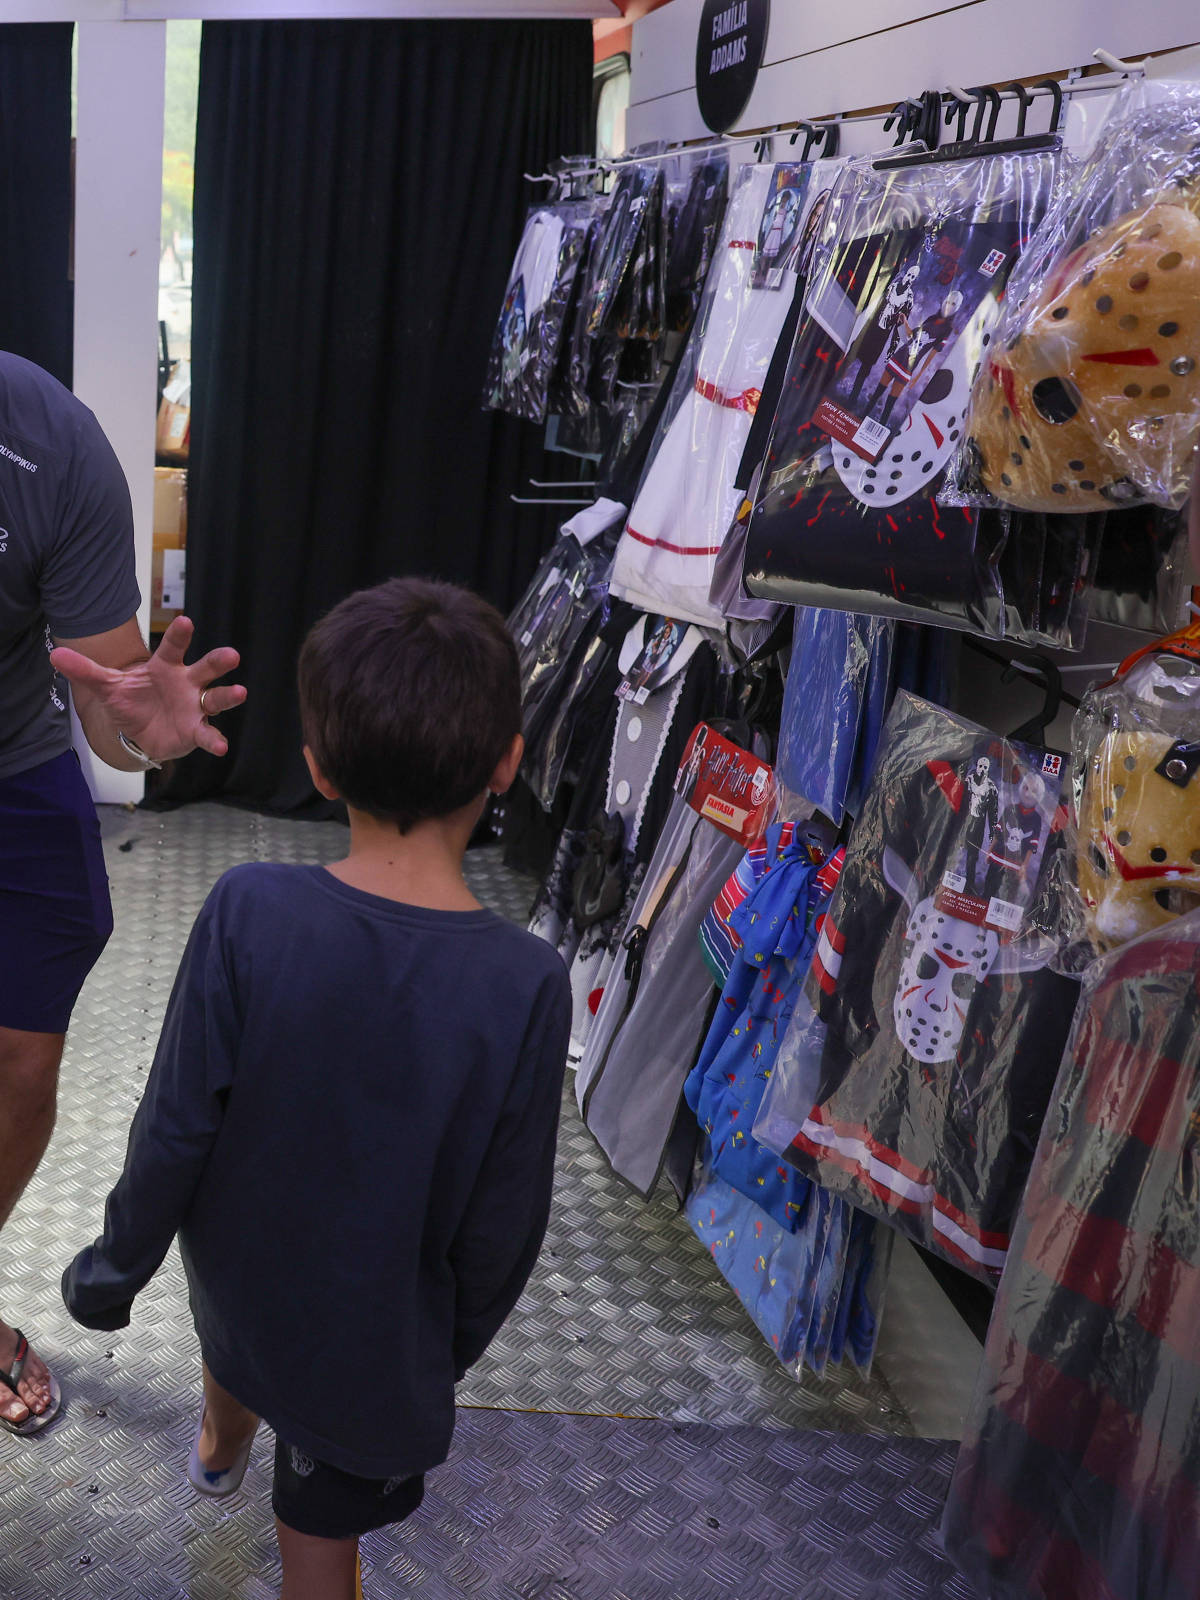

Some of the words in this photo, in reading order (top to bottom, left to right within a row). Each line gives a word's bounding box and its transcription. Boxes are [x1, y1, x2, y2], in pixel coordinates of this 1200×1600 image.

[712, 1, 747, 41] FAMÍLIA
[709, 35, 747, 75] ADDAMS
[1043, 766, 1059, 775] SULA
[706, 797, 735, 817] FANTASIA
